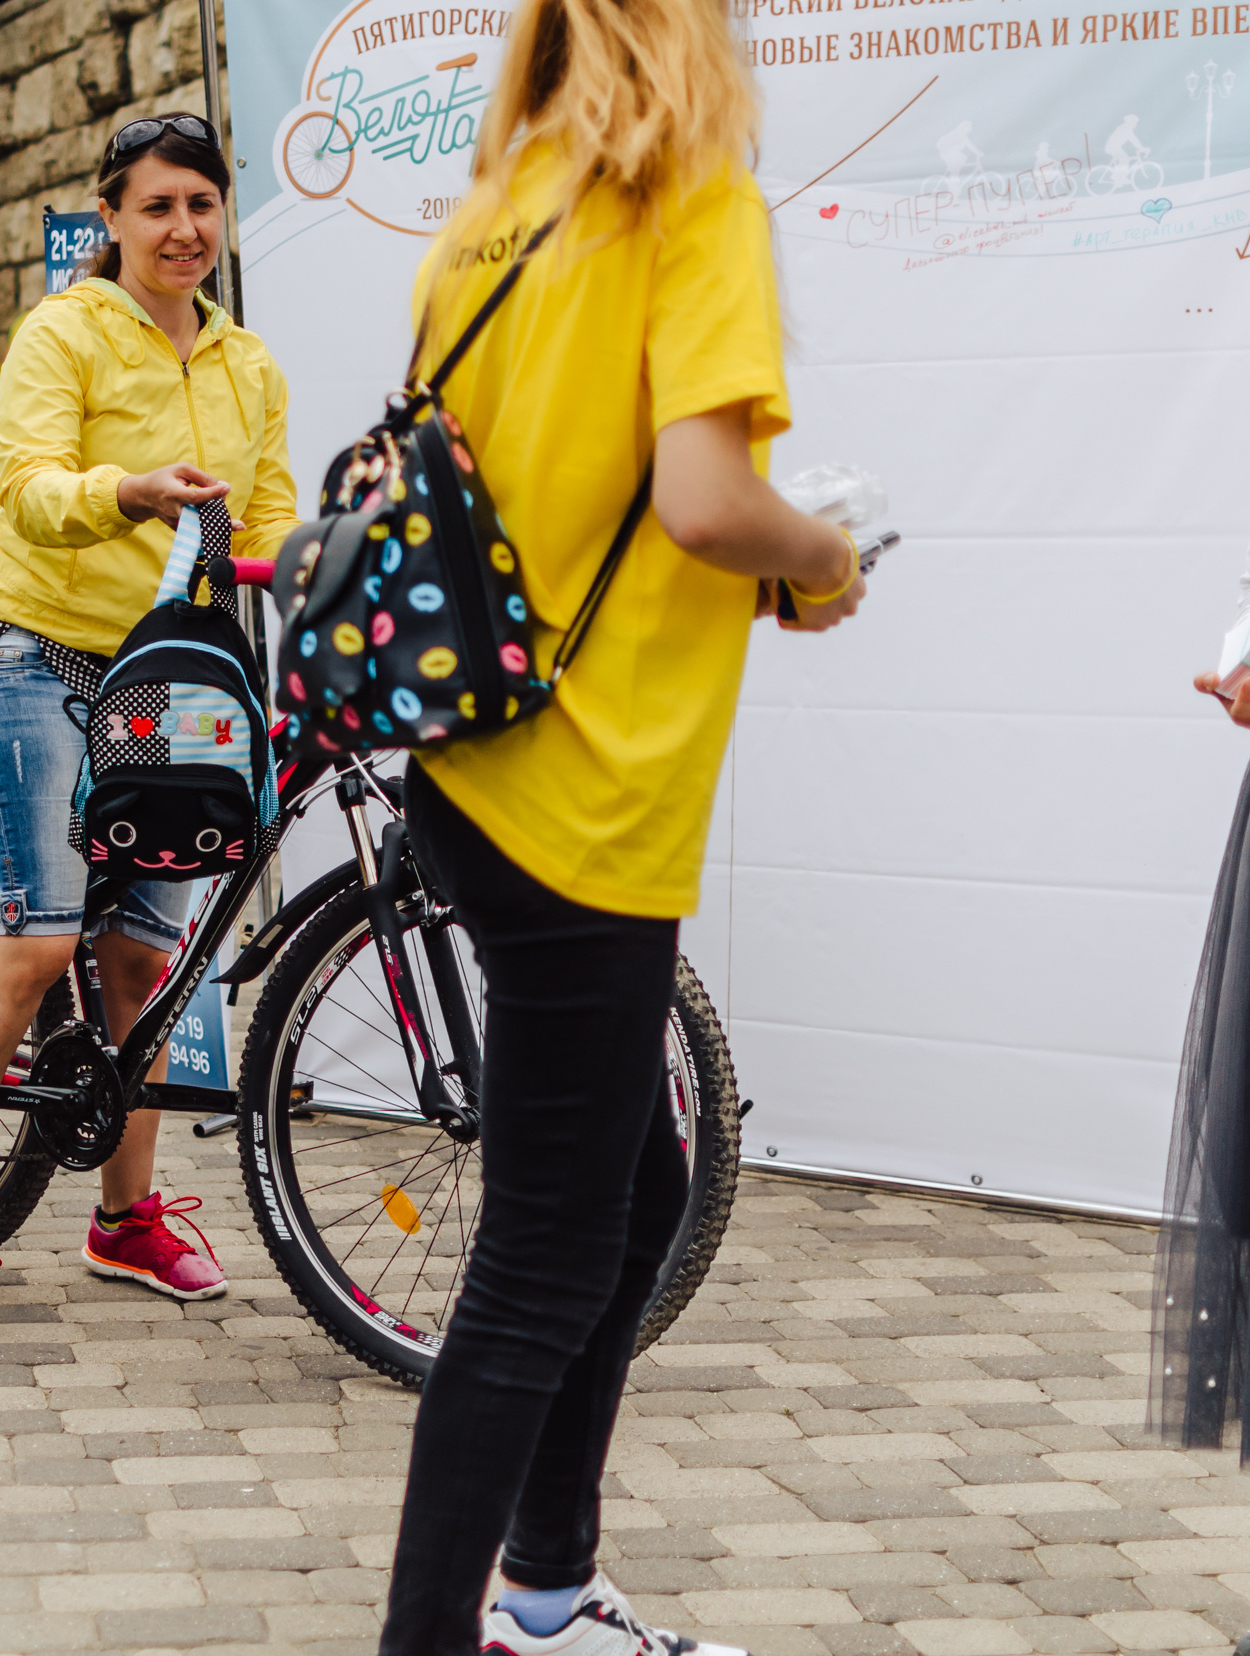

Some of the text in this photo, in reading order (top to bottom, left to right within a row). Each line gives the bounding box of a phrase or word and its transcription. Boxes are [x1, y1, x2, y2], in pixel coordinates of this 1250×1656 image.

[745, 34, 839, 67] НОВЫЕ
[850, 19, 1042, 60] ЗНАКОМСТВА
[1051, 17, 1069, 46] И
[1080, 9, 1179, 44] ЯРКИЕ
[51, 227, 95, 261] 21-22
[156, 955, 209, 1044] STERN
[253, 1143, 269, 1174] SIX
